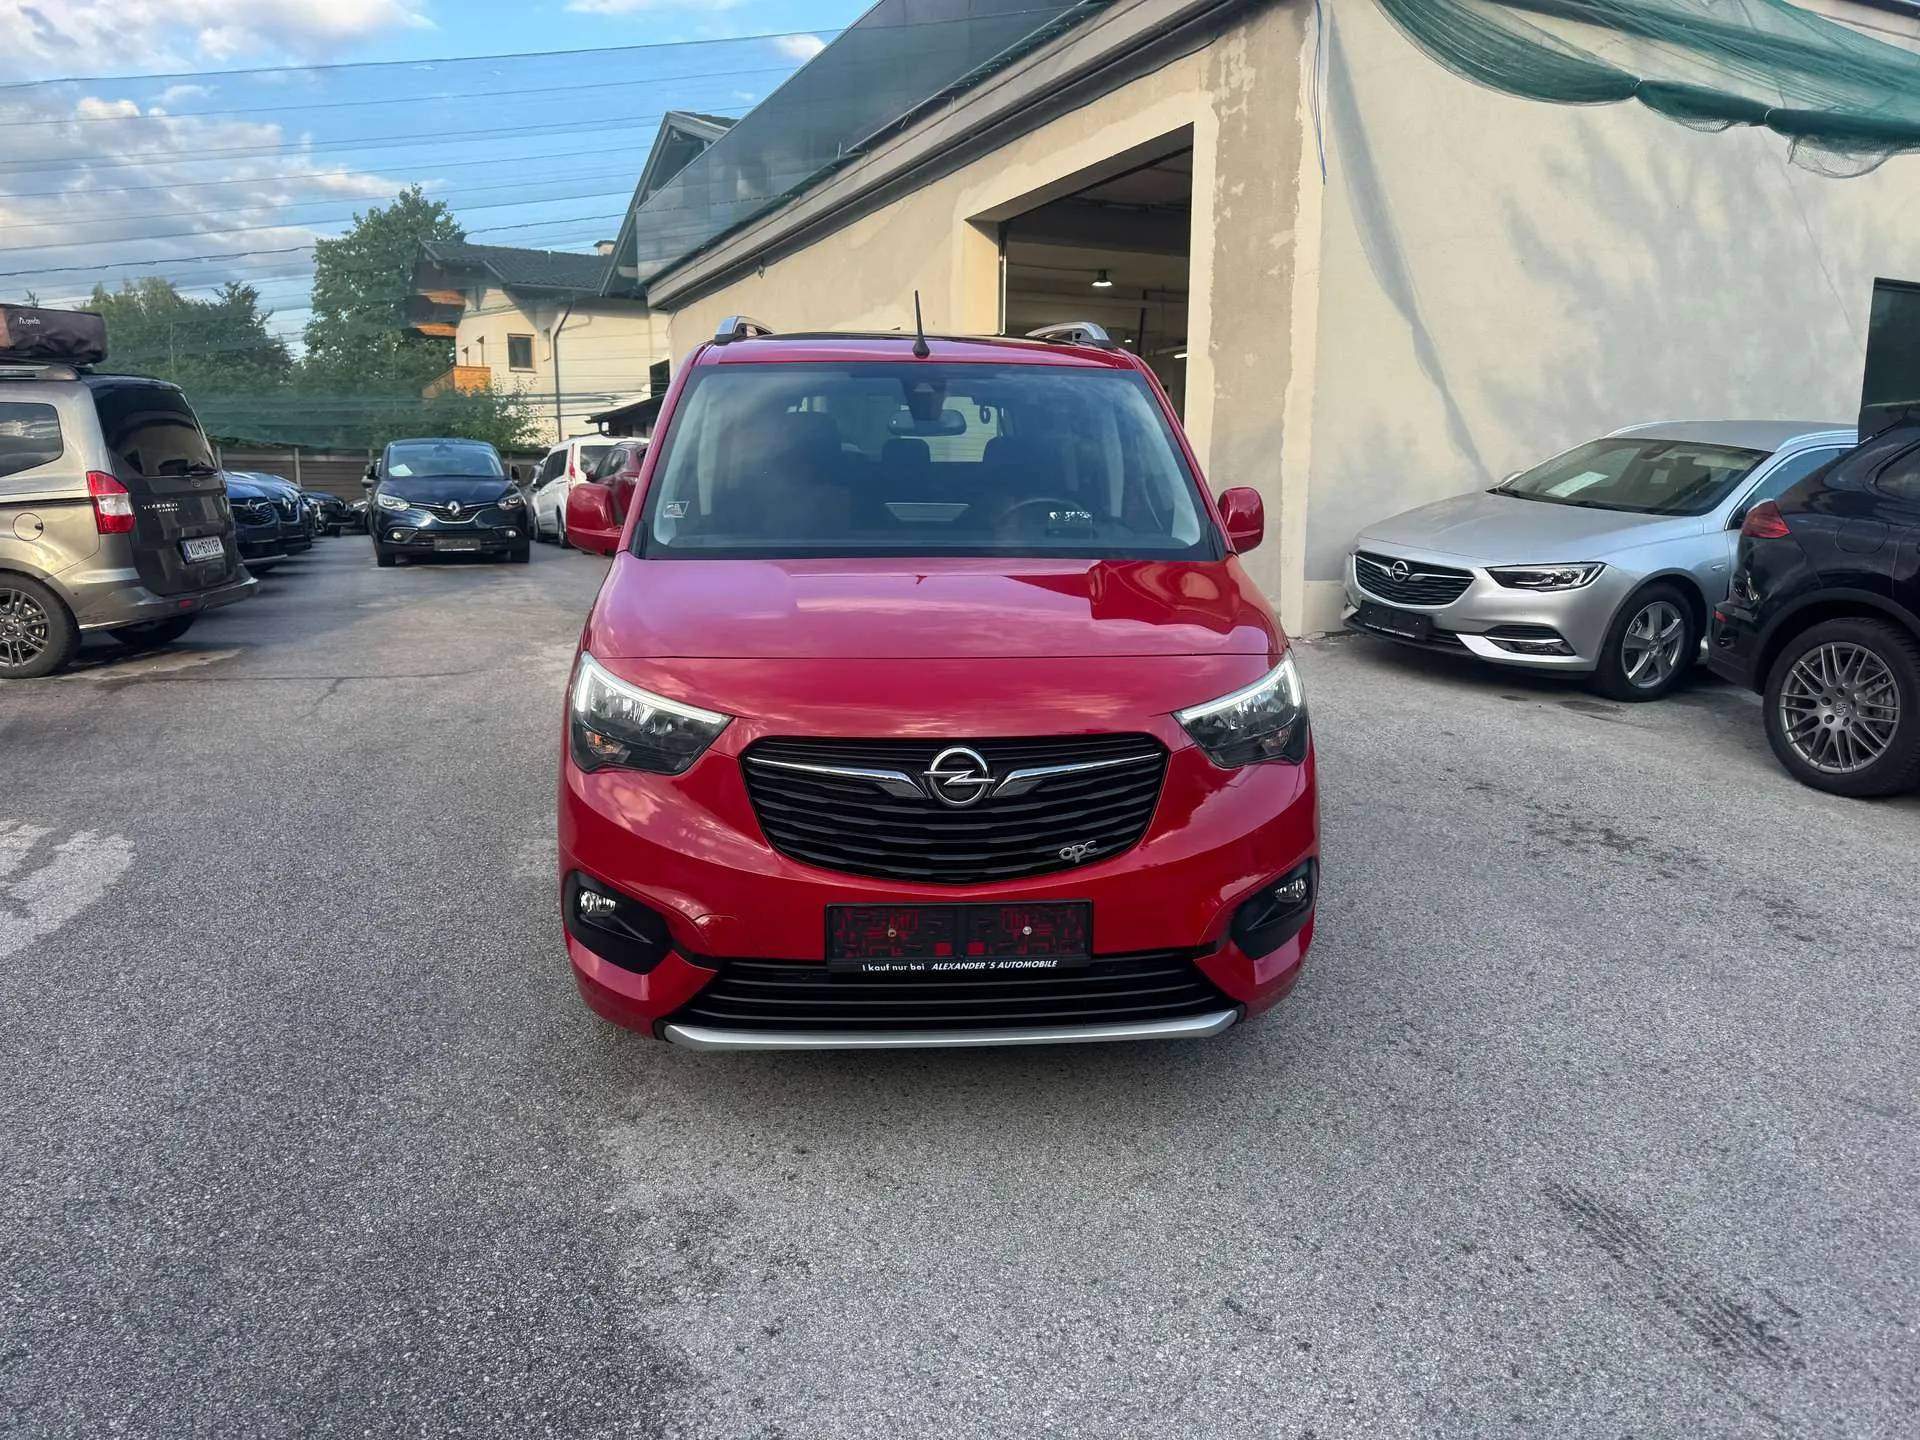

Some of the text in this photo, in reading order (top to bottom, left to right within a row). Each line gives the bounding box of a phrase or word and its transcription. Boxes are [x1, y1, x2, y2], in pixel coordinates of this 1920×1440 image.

[868, 963, 890, 971] kauf
[910, 963, 925, 971] bei
[997, 960, 1058, 969] AUTOMOBILE
